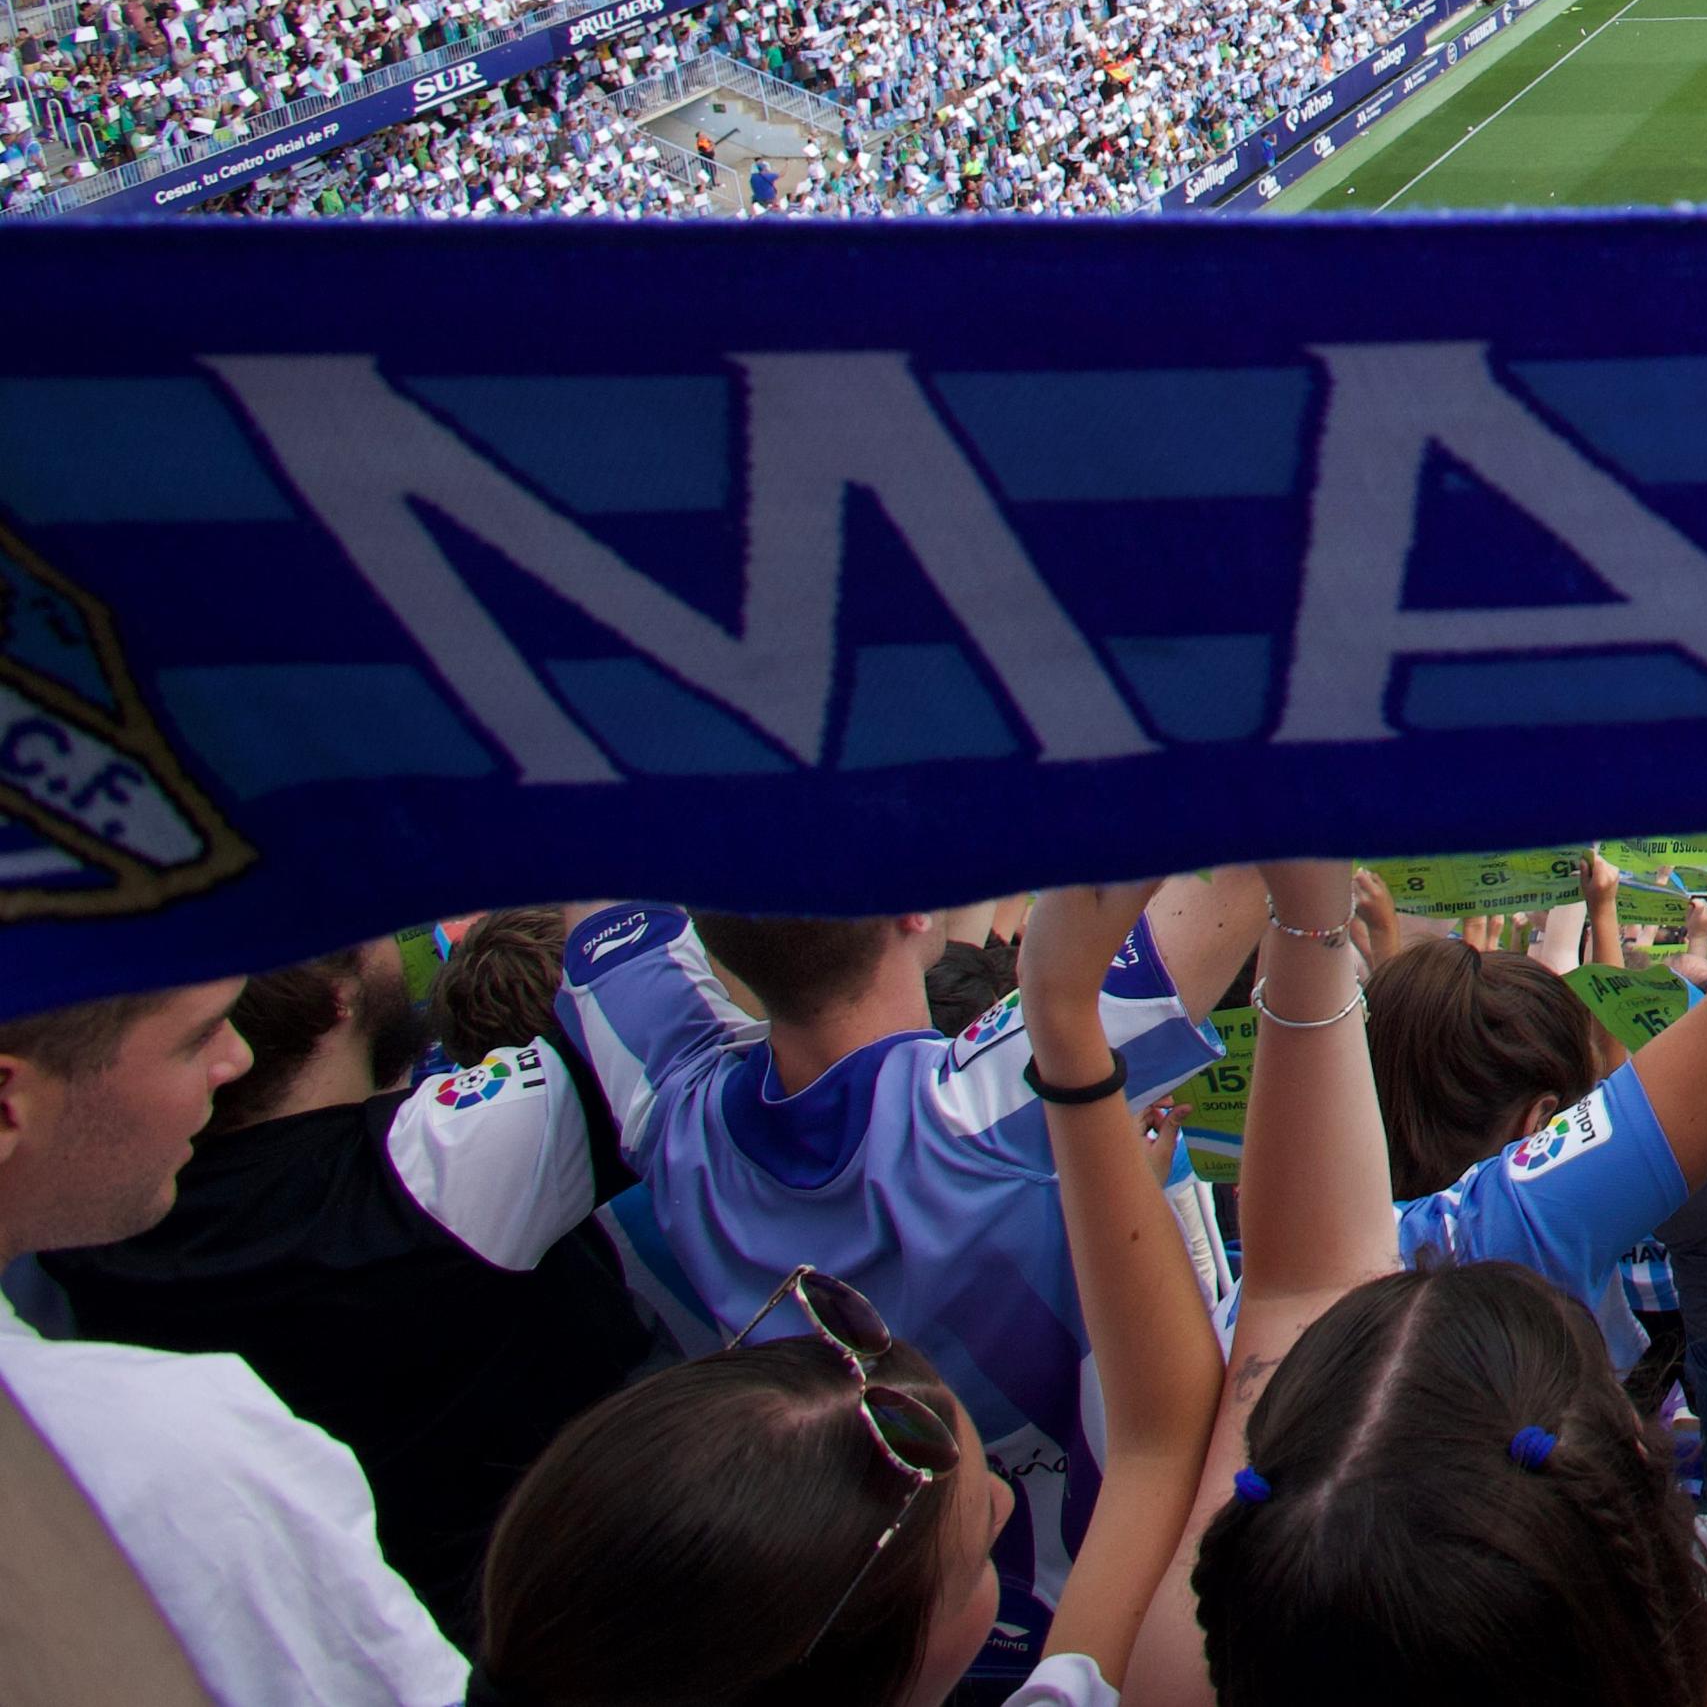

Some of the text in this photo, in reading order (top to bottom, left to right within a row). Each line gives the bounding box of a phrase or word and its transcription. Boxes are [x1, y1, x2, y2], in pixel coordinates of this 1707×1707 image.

[412, 60, 483, 102] SUR
[1300, 90, 1334, 122] vithas
[154, 122, 341, 206] Cesur, tu Centro Oficial de FP
[1406, 877, 1425, 891] 8
[1480, 871, 1511, 886] 19
[1555, 887, 1580, 902] por
[583, 911, 646, 955] LI-NING
[1240, 1019, 1258, 1038] el
[1631, 1008, 1666, 1038] 15
[1199, 1065, 1246, 1093] 15
[1202, 1100, 1247, 1111] 300Mb
